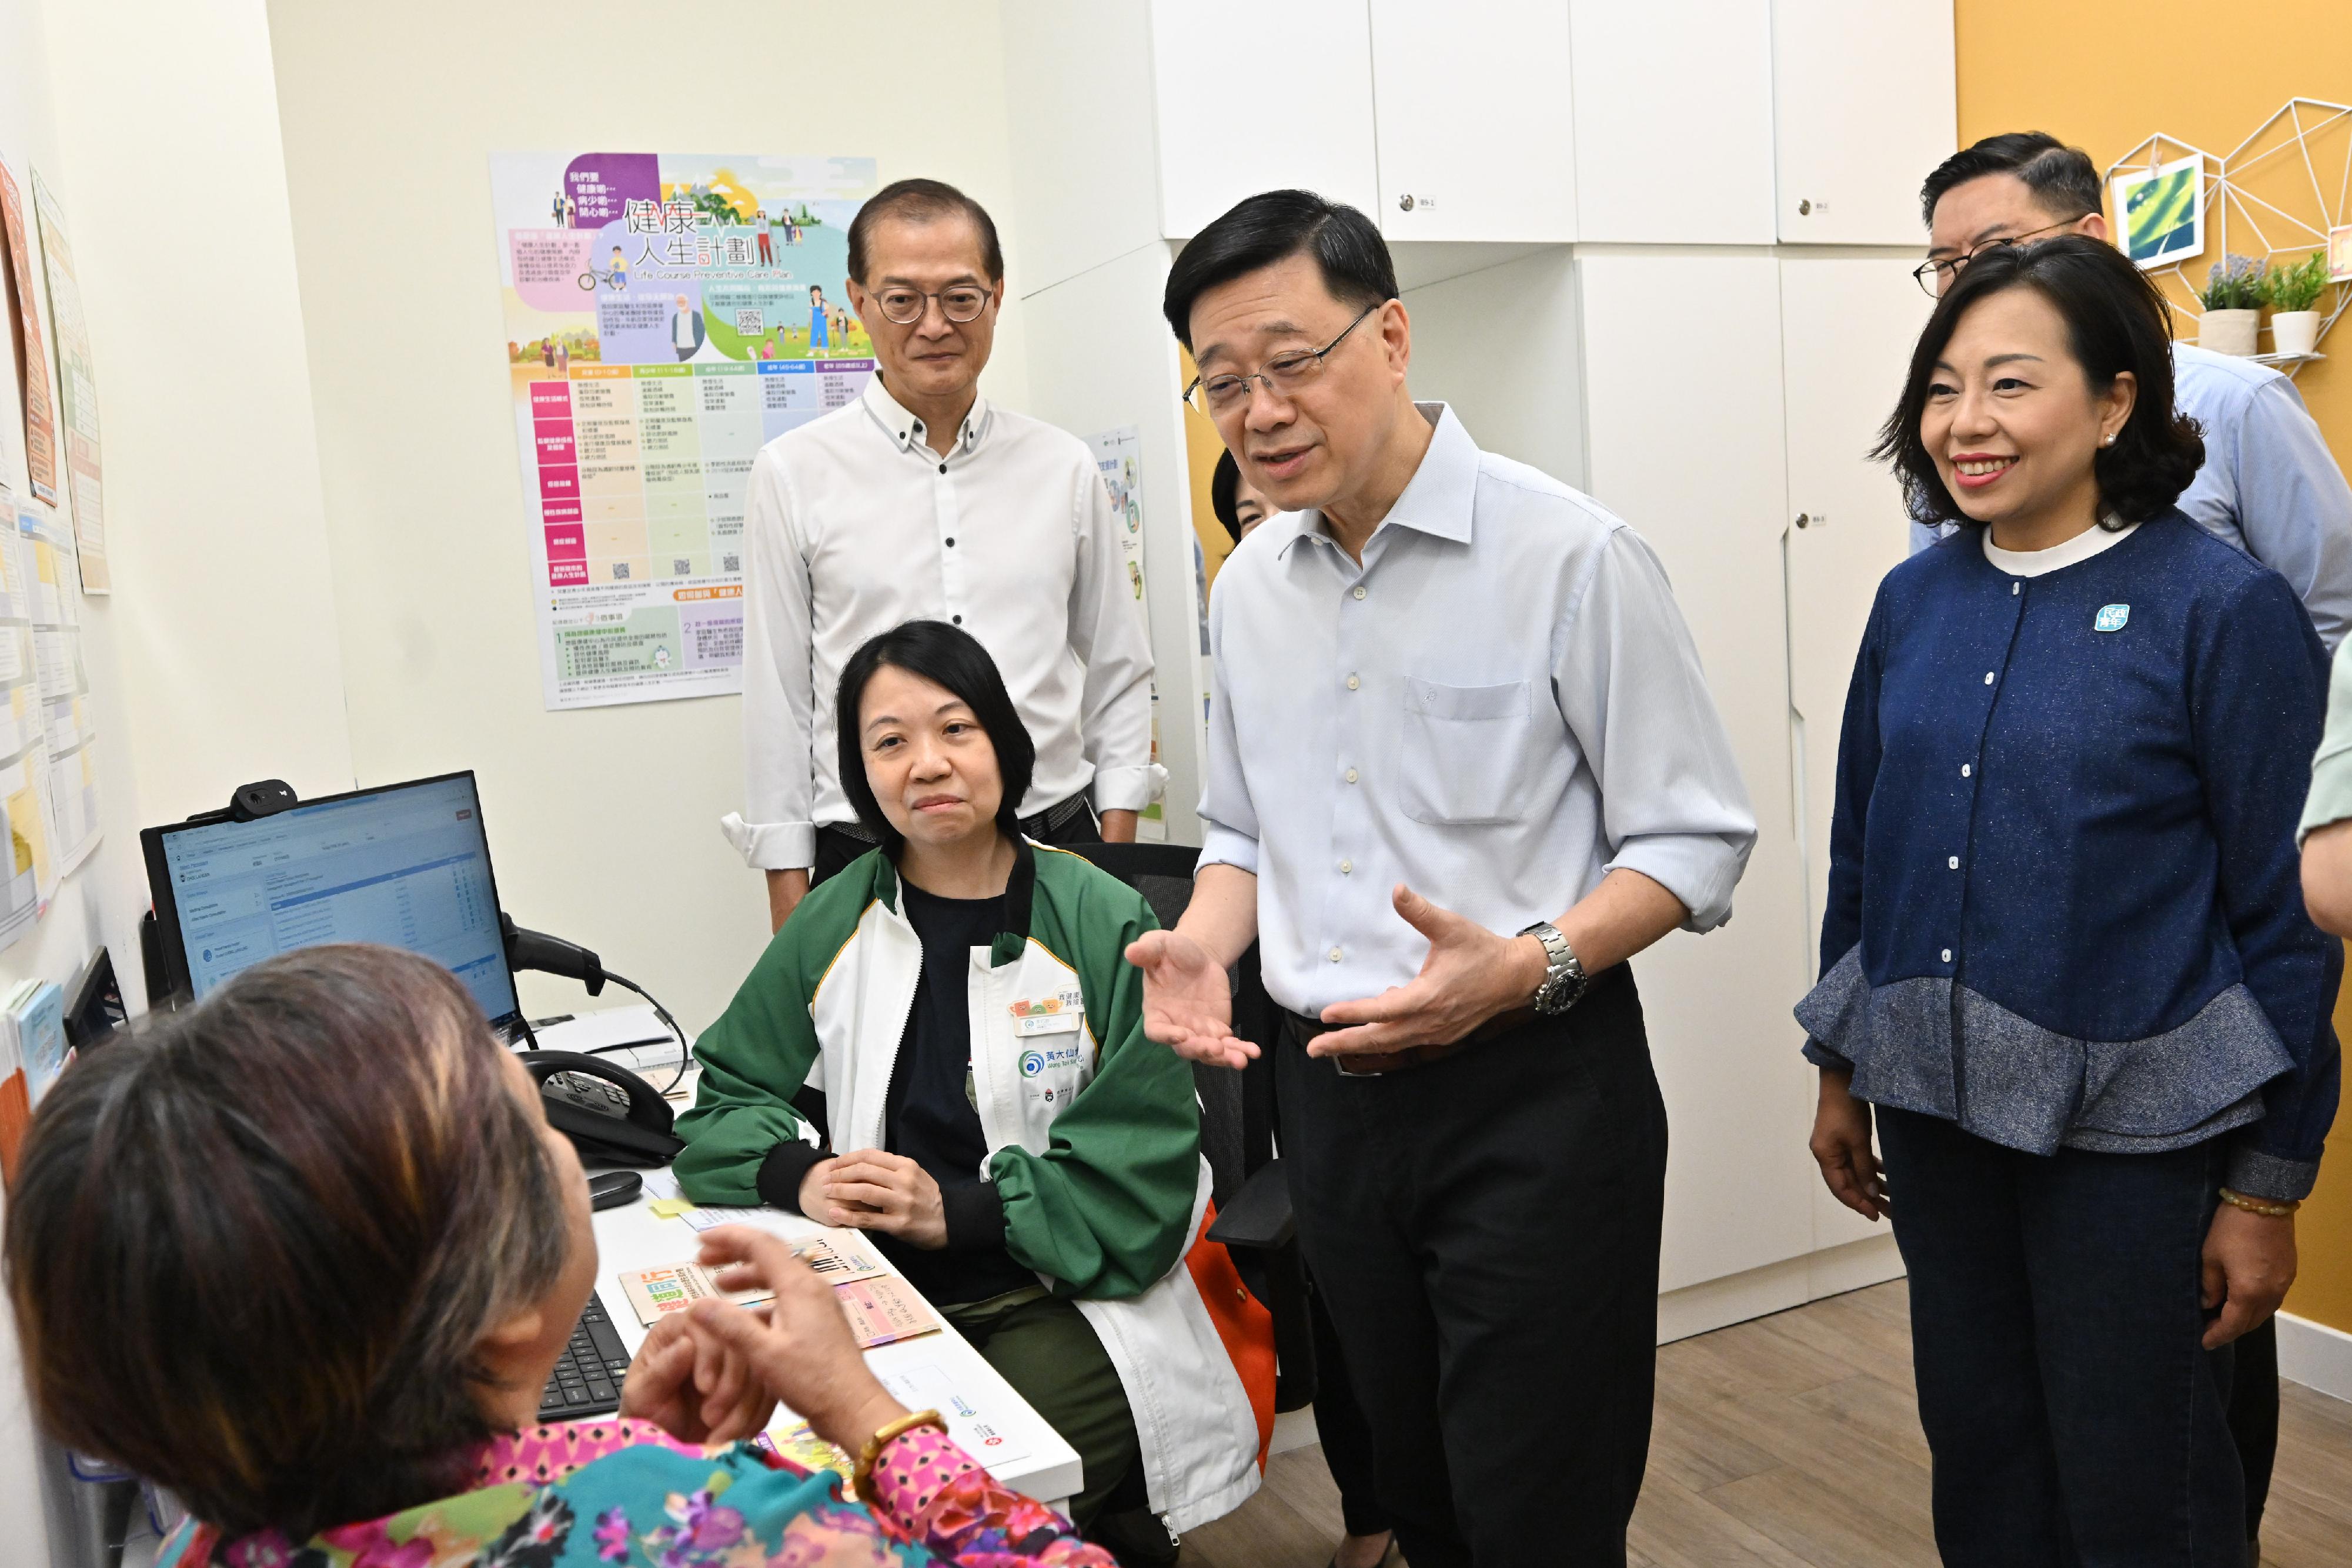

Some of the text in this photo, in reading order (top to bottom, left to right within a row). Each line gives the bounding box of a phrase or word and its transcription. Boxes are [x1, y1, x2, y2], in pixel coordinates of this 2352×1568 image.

[624, 200, 696, 234] 健康
[636, 236, 755, 265] 人生計劃
[634, 270, 792, 279] Life Course Preventive Care Plan
[684, 622, 691, 634] 2
[556, 633, 561, 643] 1
